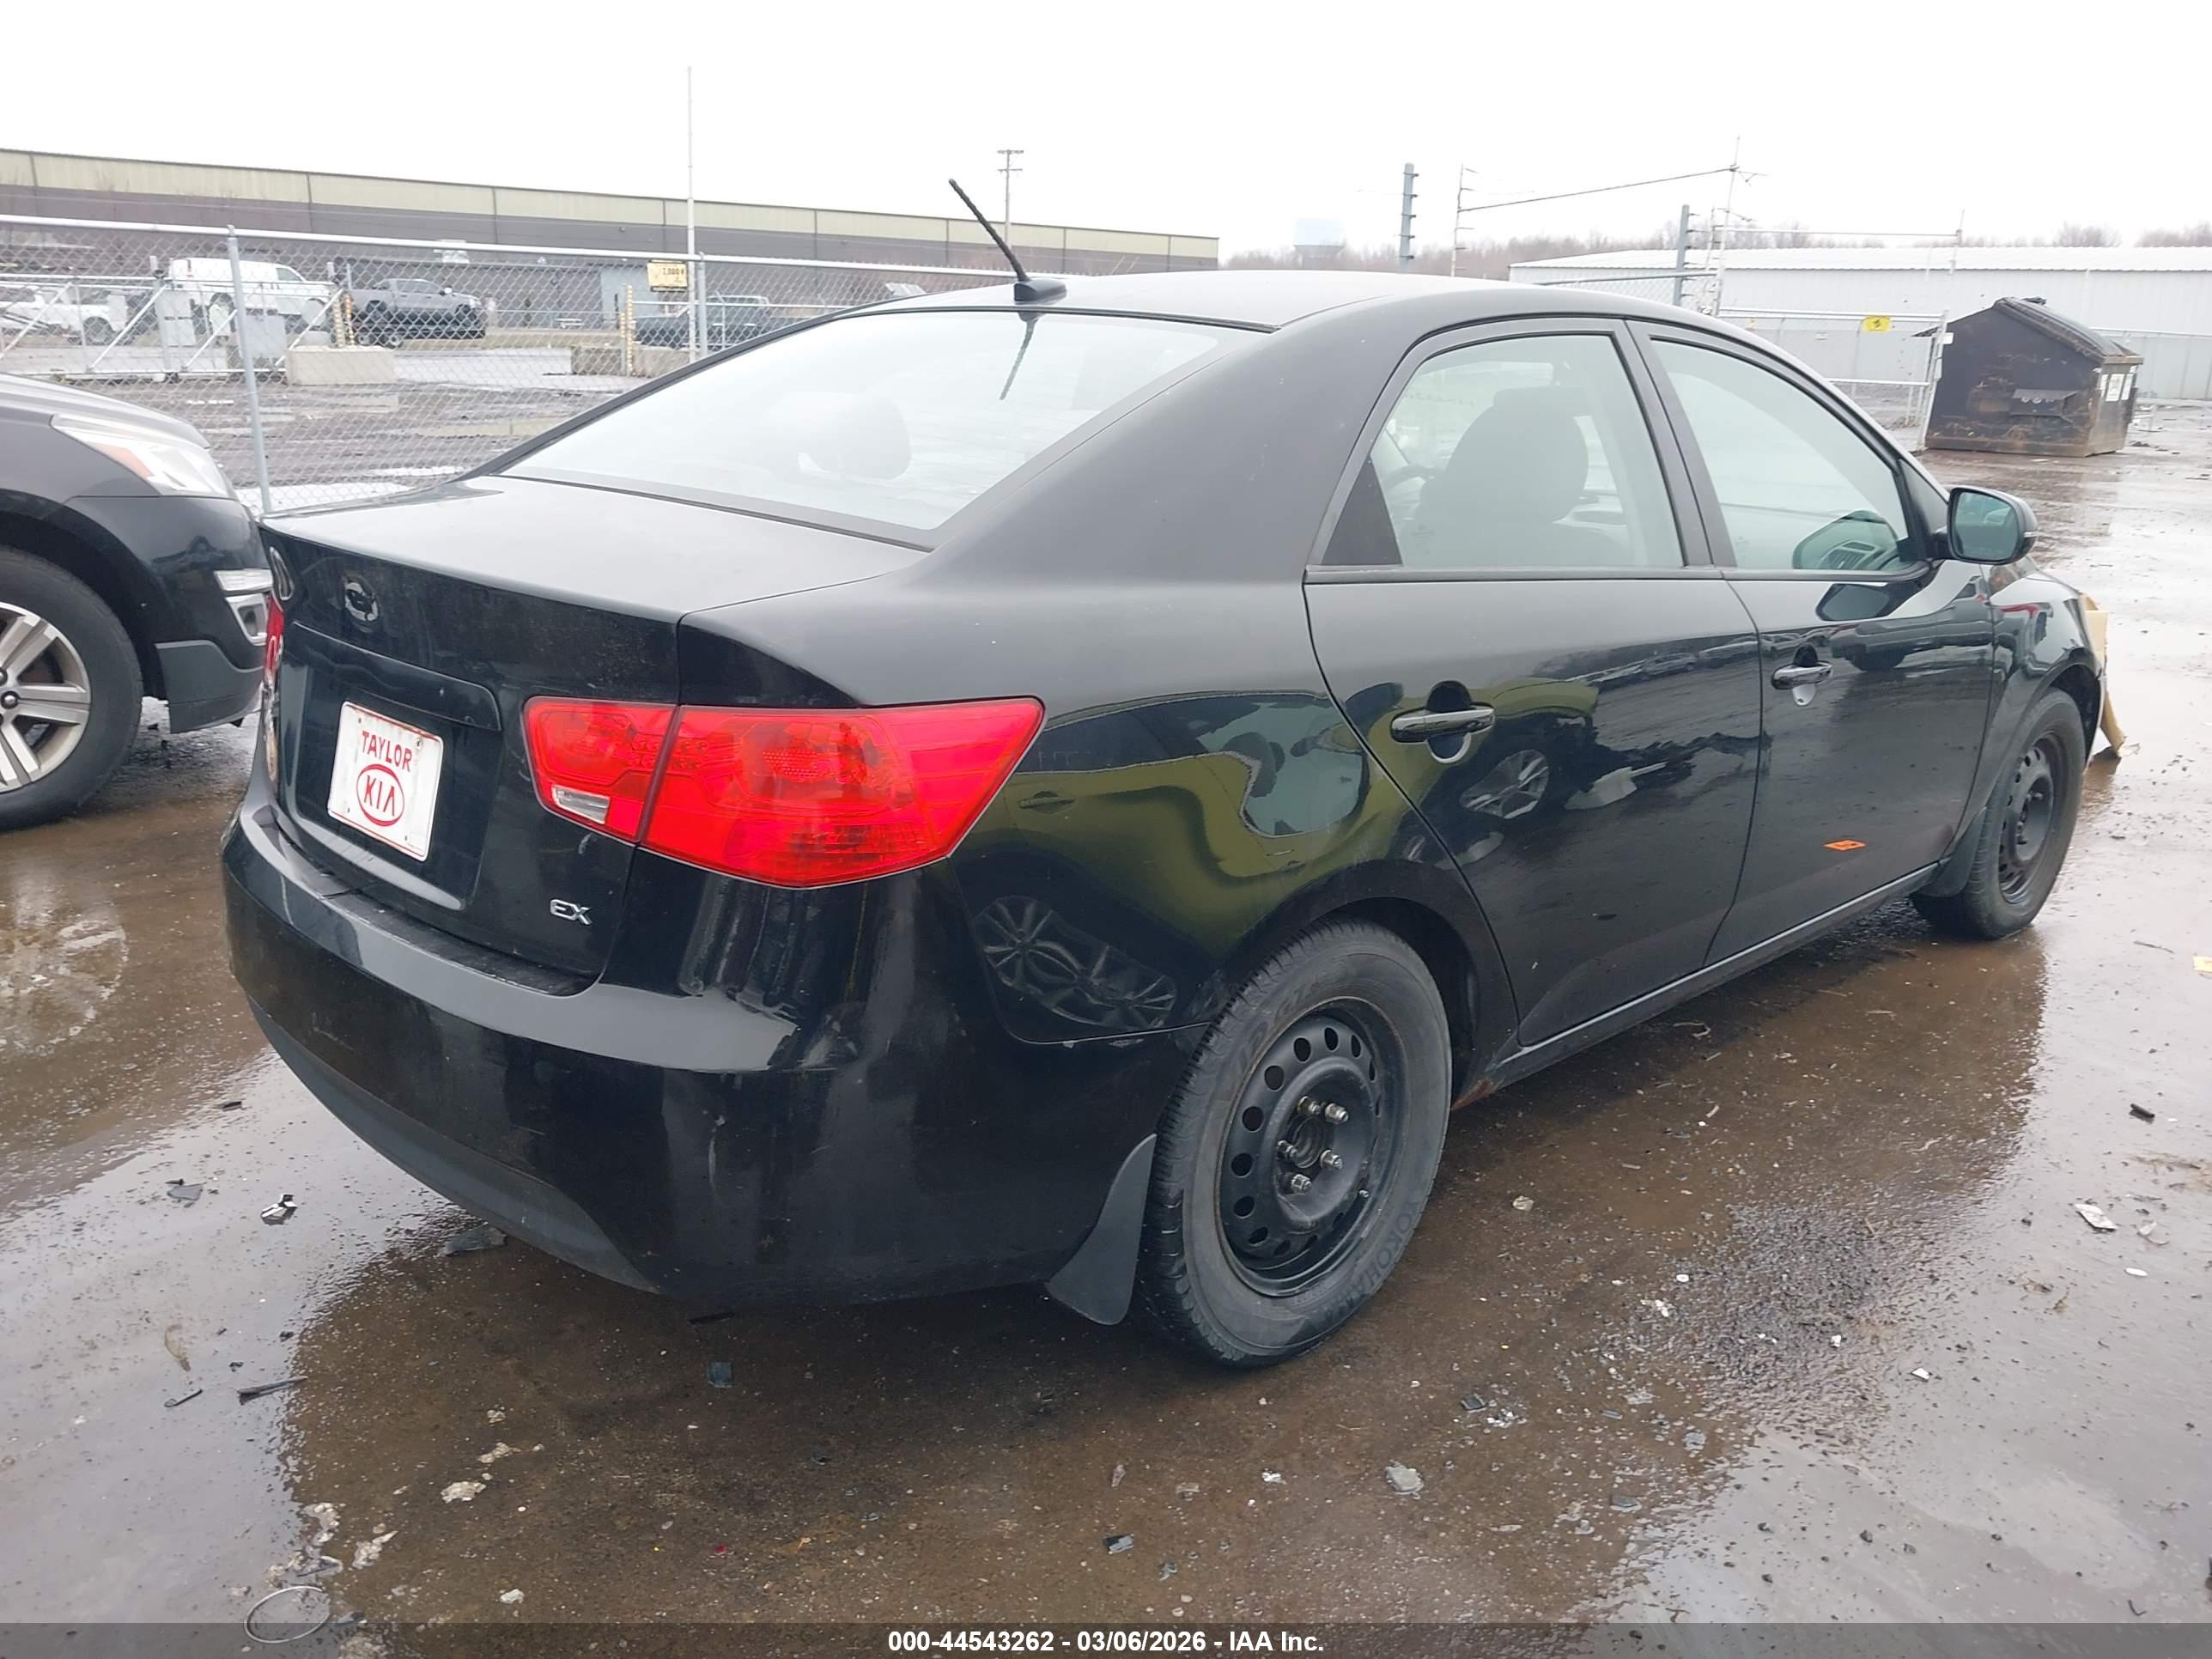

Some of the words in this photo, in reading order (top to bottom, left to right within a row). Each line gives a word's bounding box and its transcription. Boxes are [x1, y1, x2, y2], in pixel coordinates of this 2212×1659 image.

[362, 730, 413, 772] TAYLOR
[363, 775, 396, 817] KIA
[550, 899, 592, 925] EX
